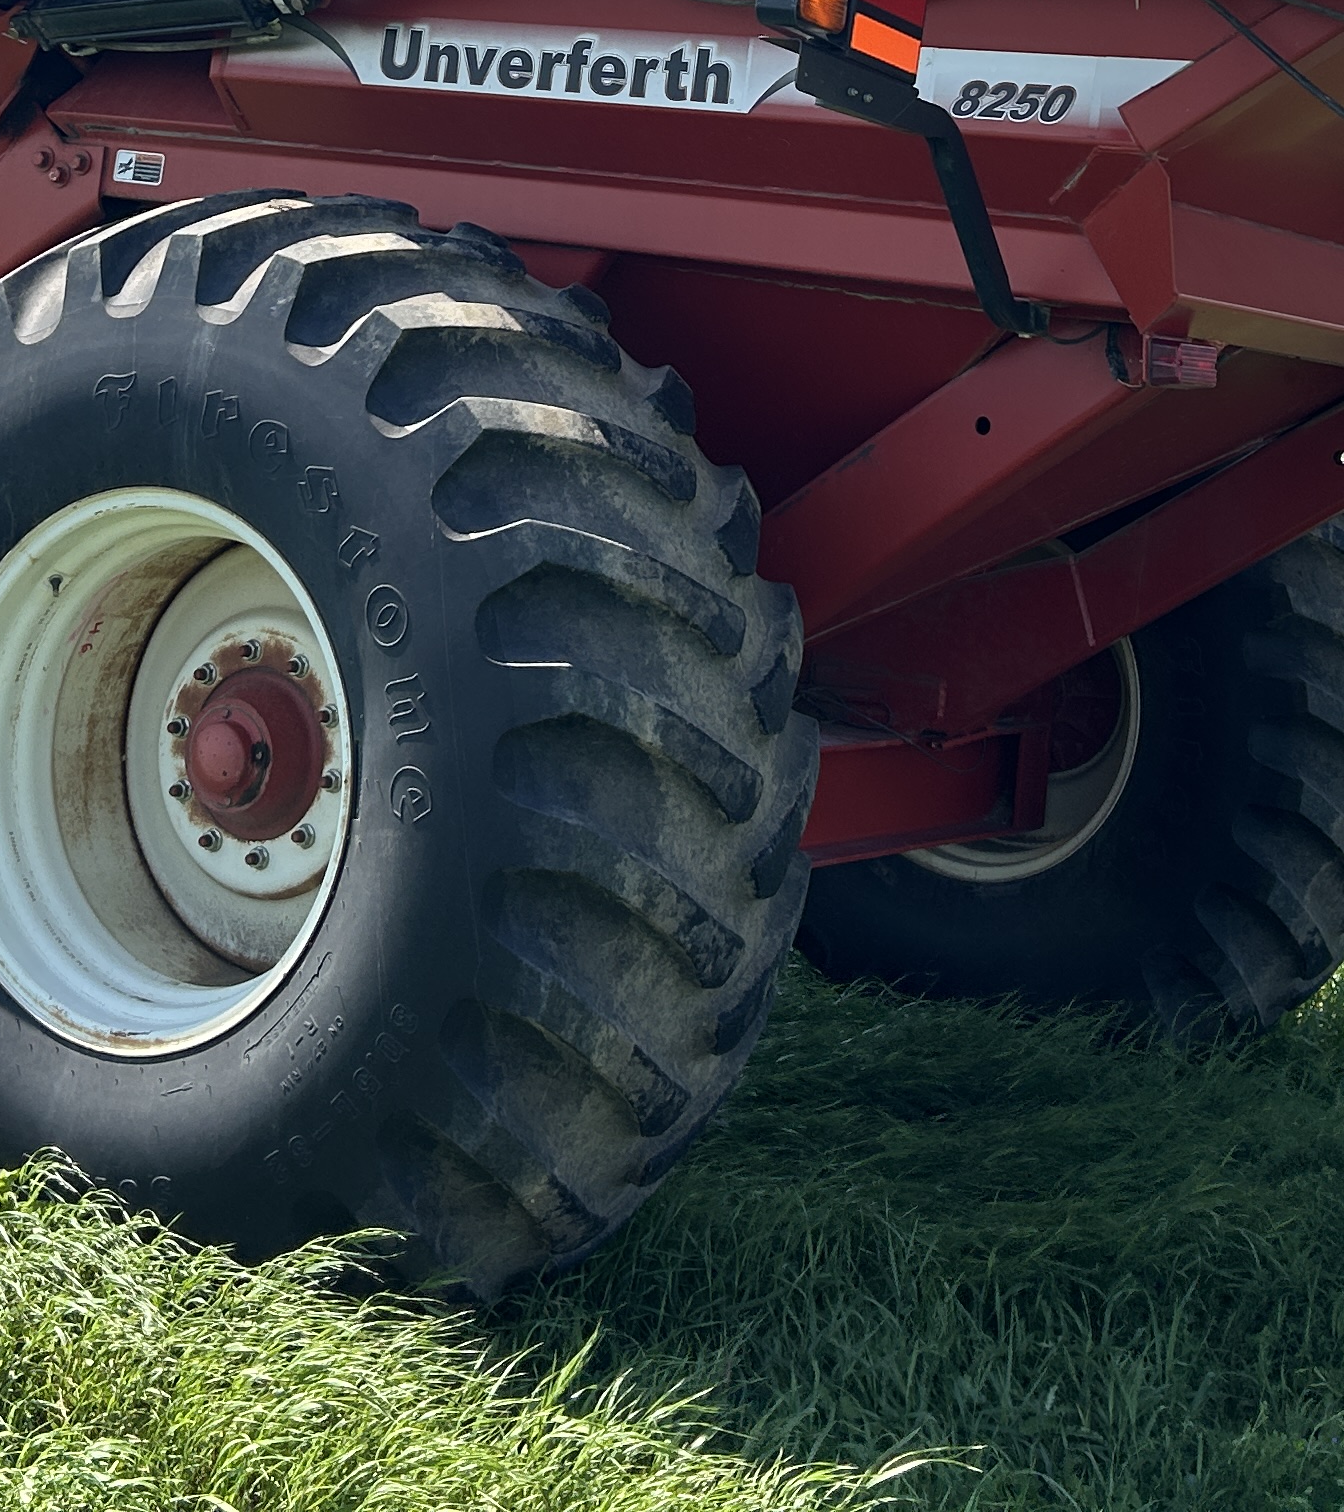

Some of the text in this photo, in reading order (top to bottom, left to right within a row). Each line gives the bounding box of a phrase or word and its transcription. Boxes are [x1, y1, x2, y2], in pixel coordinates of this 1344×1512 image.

[379, 27, 732, 106] Unverferth
[949, 79, 1078, 125] 8250
[93, 370, 433, 825] Firestone
